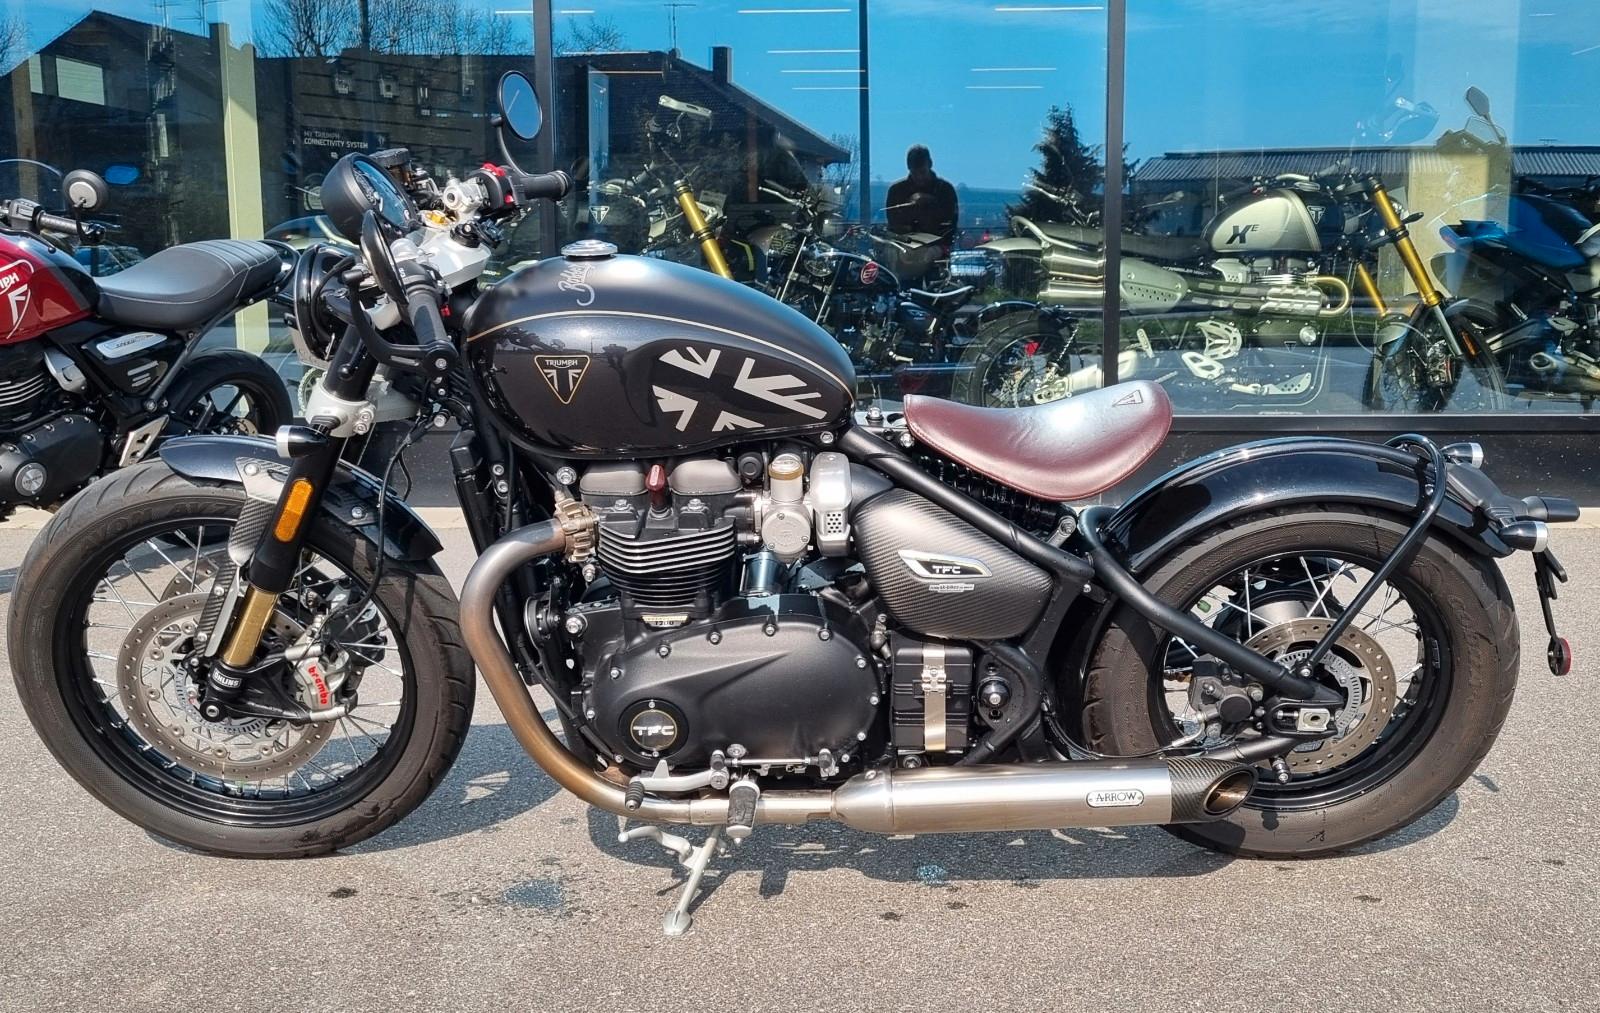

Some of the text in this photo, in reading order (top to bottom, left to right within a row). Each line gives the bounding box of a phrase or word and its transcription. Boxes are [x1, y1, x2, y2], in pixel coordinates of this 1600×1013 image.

[304, 138, 369, 149] CONNECTIVITY SYSTEM
[544, 358, 579, 369] TRIUMPH
[931, 564, 962, 575] TFC
[307, 665, 328, 705] brembo
[1095, 791, 1137, 802] ARROW
